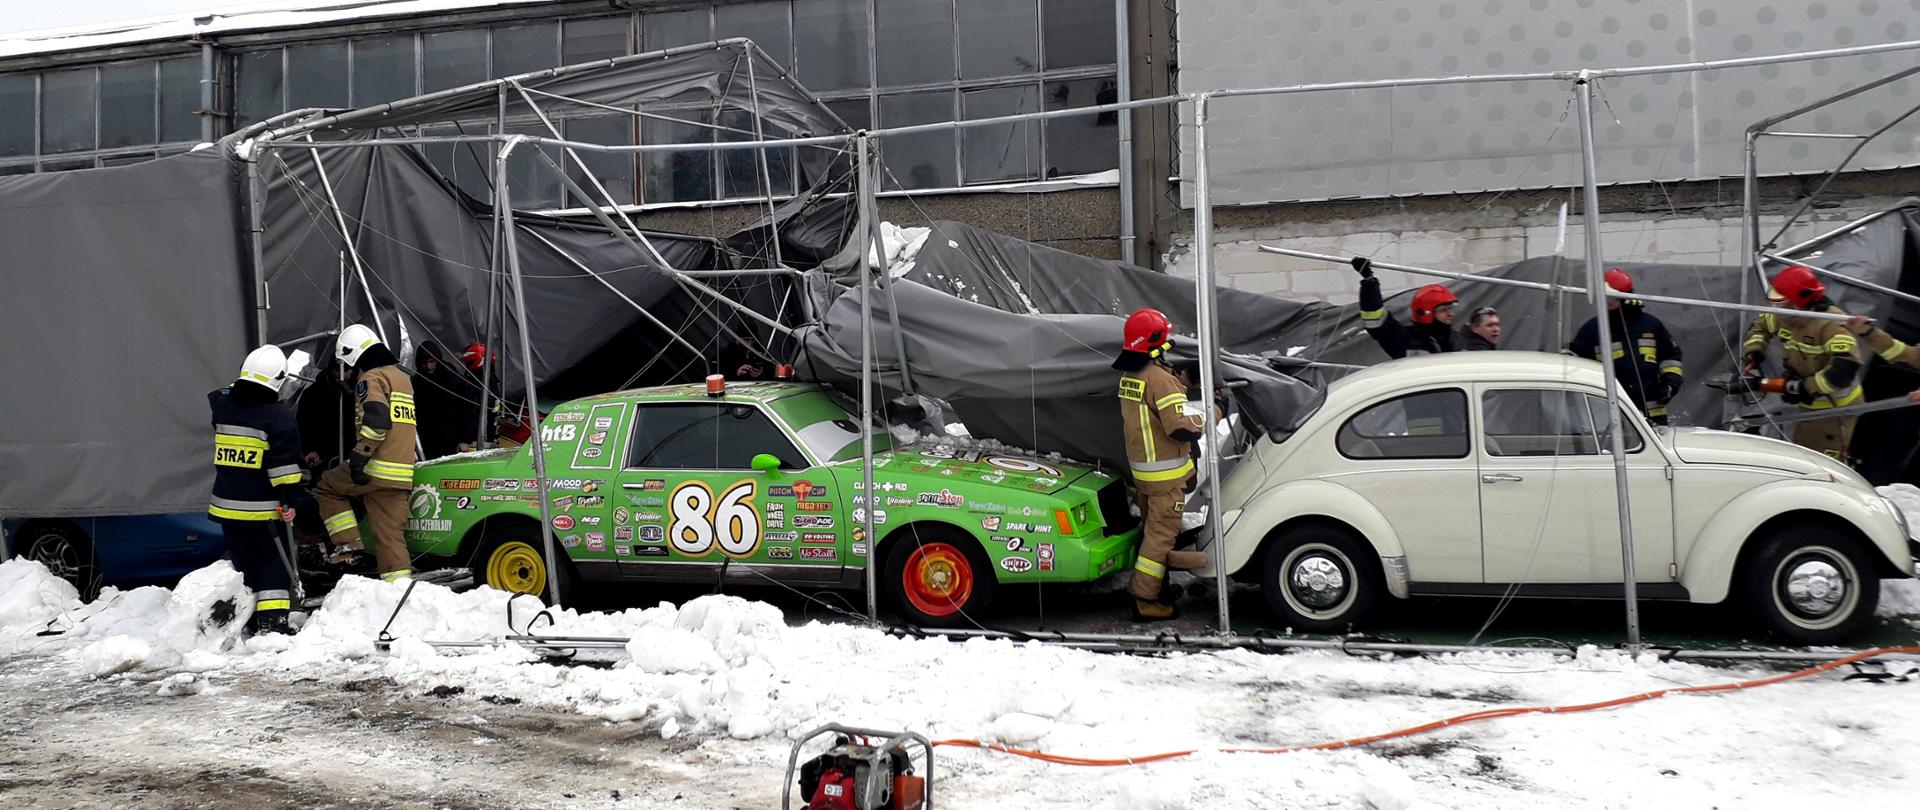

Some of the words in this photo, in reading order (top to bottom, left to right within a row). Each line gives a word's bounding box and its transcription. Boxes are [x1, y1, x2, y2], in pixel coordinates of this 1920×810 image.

[552, 479, 582, 488] MOOD
[769, 487, 792, 495] PISTON
[811, 487, 826, 495] CUP
[668, 480, 762, 557] 86
[766, 511, 784, 520] WHEEL
[766, 520, 784, 529] DRIVE
[1006, 522, 1027, 531] SPARE
[1033, 524, 1052, 533] MINT
